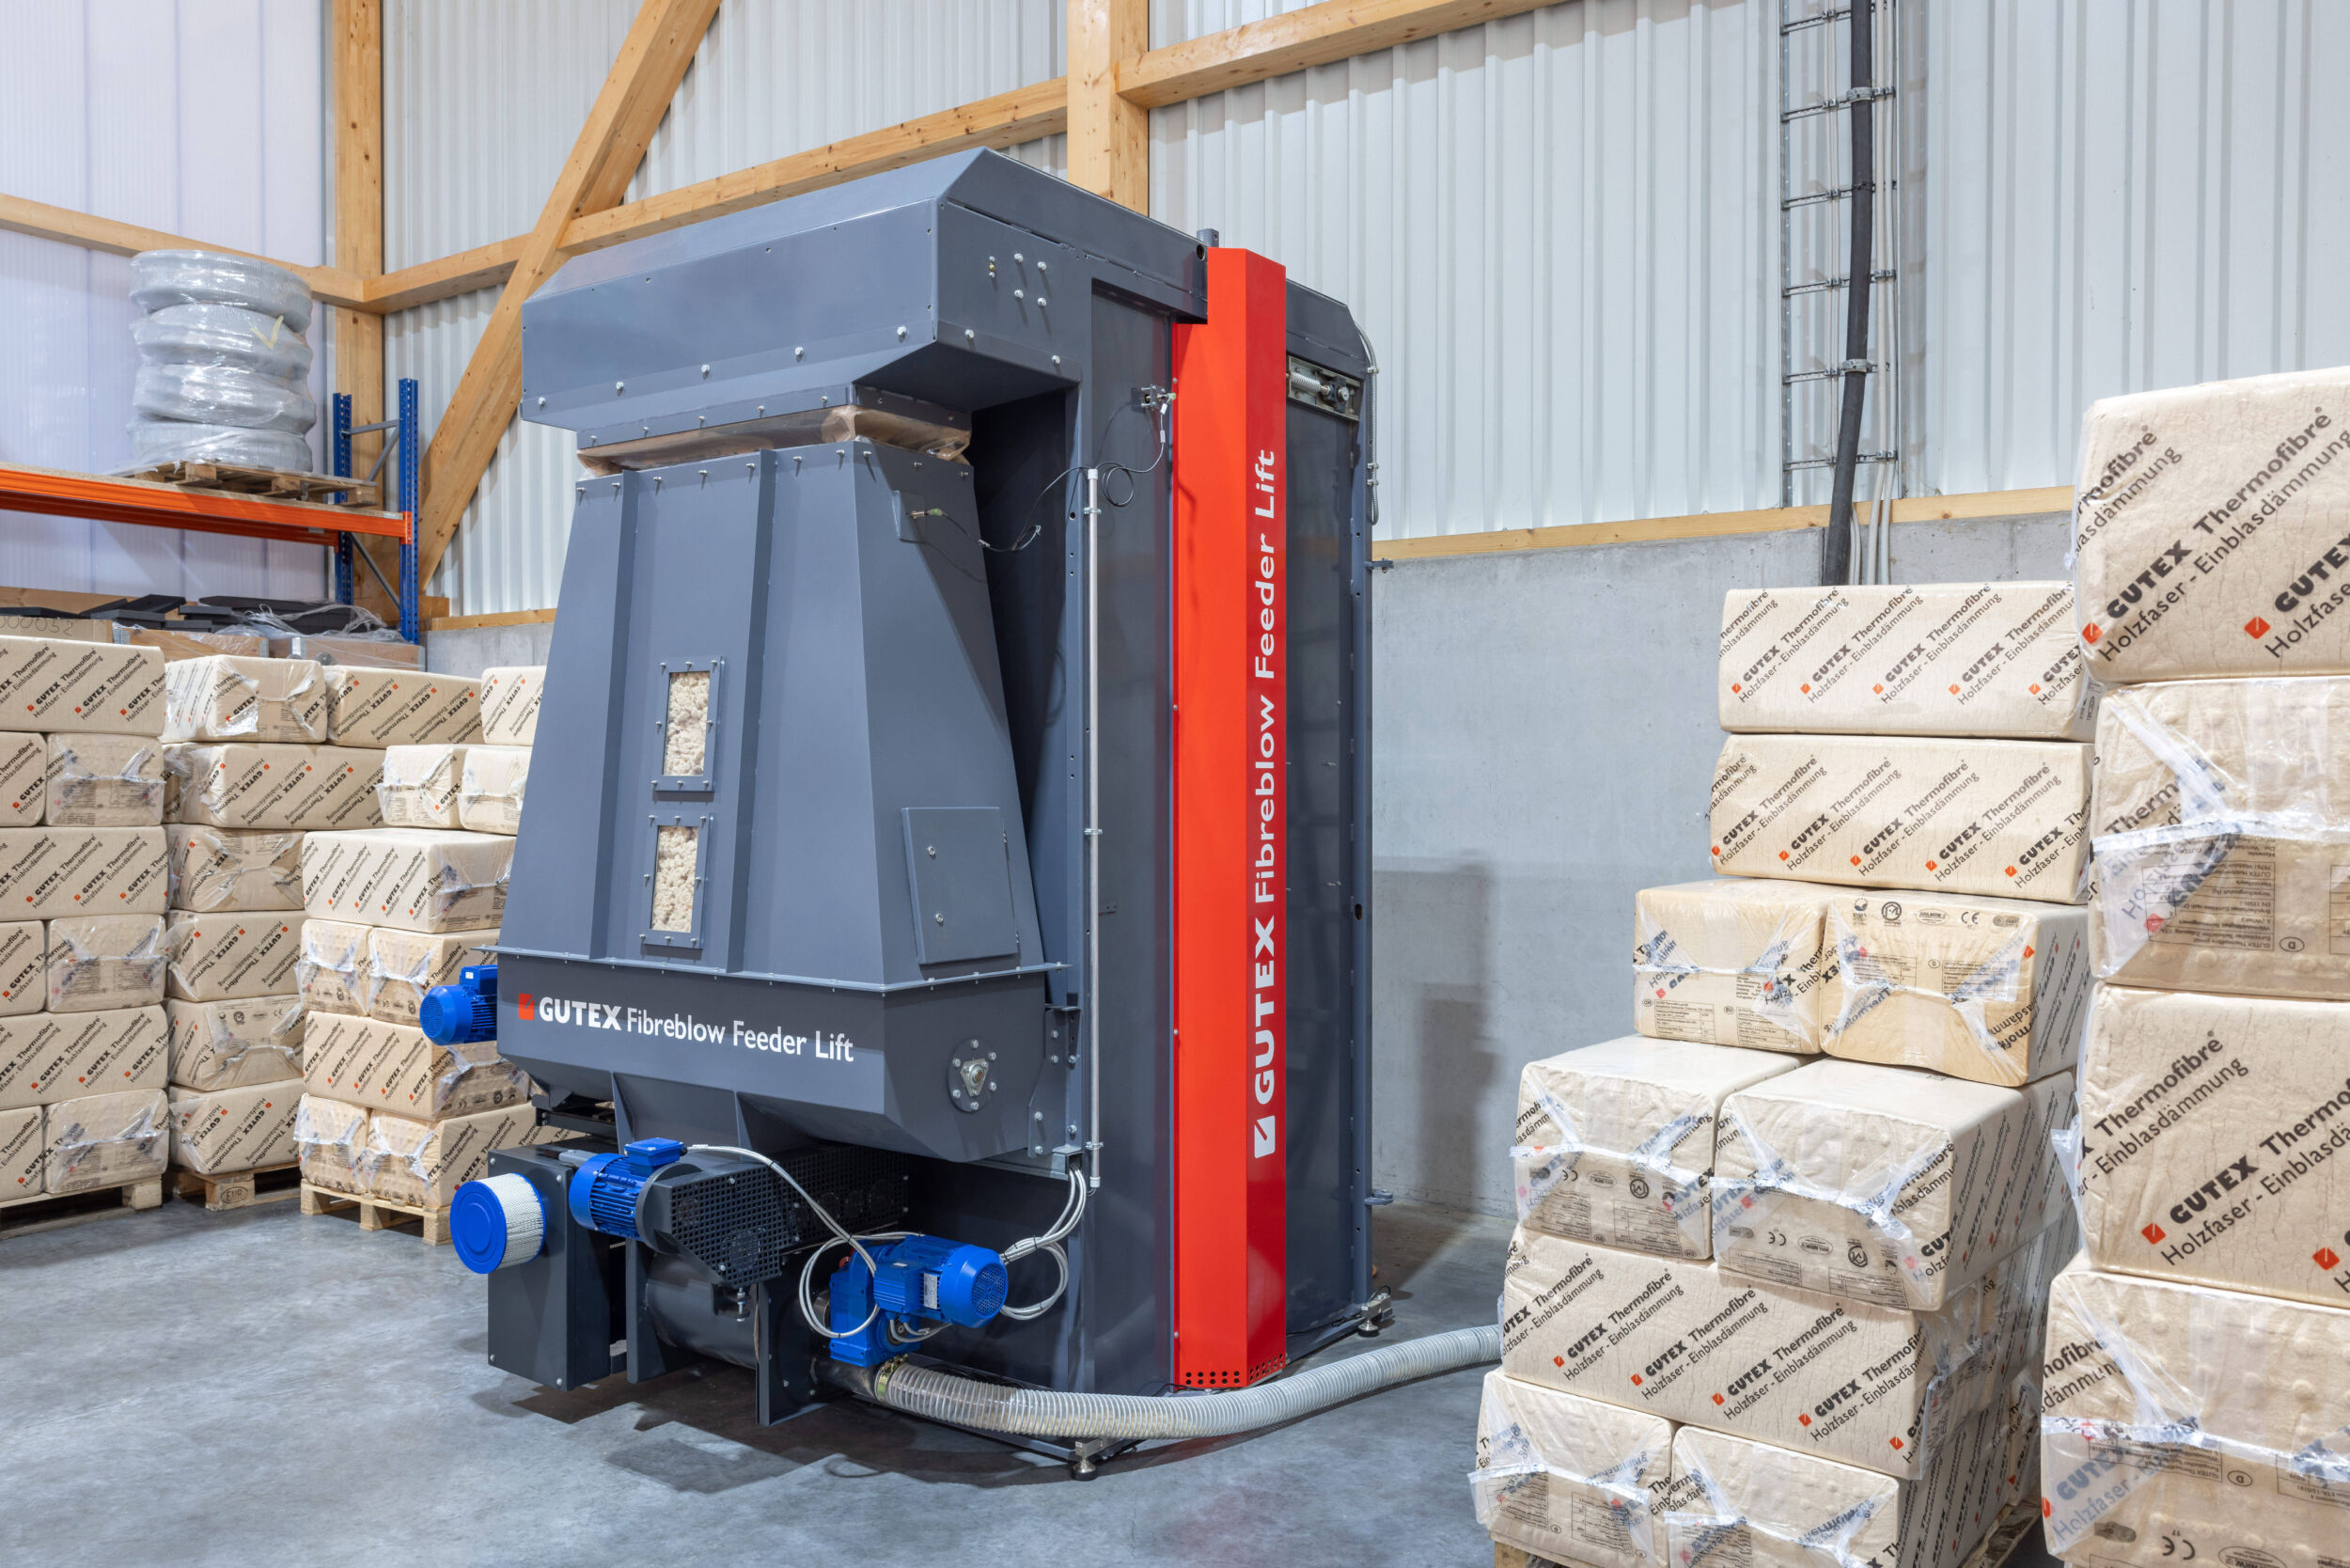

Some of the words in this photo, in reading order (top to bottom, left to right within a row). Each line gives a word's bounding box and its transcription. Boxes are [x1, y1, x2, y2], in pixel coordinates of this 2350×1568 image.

[1255, 449, 1275, 519] Lift
[2106, 540, 2193, 619] GUTEX
[1255, 533, 1275, 679] Feeder
[2099, 581, 2186, 662] Holzfaser
[2264, 588, 2350, 658] Holzfase
[1743, 645, 1780, 682] GUTEX
[1812, 644, 1851, 682] GUTEX
[1885, 643, 1926, 682] GUTEX
[1962, 643, 2005, 682] GUTEX
[36, 682, 60, 705] GUTEX
[83, 684, 106, 707] GUTEX
[128, 687, 151, 710] GUTEX
[1739, 666, 1777, 703] Holzfaser
[1809, 666, 1847, 703] Holzfaser
[1881, 666, 1922, 704] Holzfaser
[1958, 666, 2001, 705] Holzfaser
[20, 776, 44, 800] GUTEX
[240, 771, 263, 792] GUTEX
[283, 772, 306, 793] GUTEX
[1255, 694, 1275, 903] Fibreblow
[1722, 810, 1759, 845] GUTEX
[1791, 813, 1829, 850] GUTEX
[1863, 818, 1904, 855] GUTEX
[1939, 822, 1982, 859] GUTEX
[2019, 827, 2063, 865] GUTEX
[1719, 831, 1756, 865] Holzfaser
[1787, 834, 1826, 871] Holzfaser
[1858, 839, 1900, 876] Holzfaser
[1935, 843, 1978, 882] Holzfaser
[35, 870, 60, 895] GUTEX
[83, 870, 106, 893] GUTEX
[128, 869, 150, 892] GUTEX
[2014, 848, 2060, 888] Holzfaser
[216, 936, 239, 960] GUTEX
[259, 933, 282, 956] GUTEX
[9, 964, 35, 988] GUTEX
[1254, 914, 1276, 1105] GUTEX
[539, 996, 621, 1031] GUTEX
[627, 1008, 726, 1045] Fibreblow
[732, 1020, 807, 1055] Feeder
[816, 1030, 854, 1062] Lift
[39, 1056, 65, 1081] GUTEX
[86, 1050, 111, 1075] GUTEX
[133, 1045, 156, 1070] GUTEX
[244, 1109, 265, 1135] GUTEX
[2095, 1057, 2249, 1175] Einblasdämmung
[2170, 1154, 2259, 1224] GUTEX
[2259, 1077, 2350, 1156] Thermo
[2160, 1195, 2251, 1266] Holzfaser
[1532, 1268, 1604, 1329] Einblasdämmung
[1564, 1344, 1605, 1381] Holzfaser
[1607, 1284, 1684, 1346] Einblasdämmung
[1567, 1323, 1607, 1358] GUTEX
[1641, 1363, 1684, 1400] Holzfaser
[1688, 1300, 1768, 1364] Einblasdämmung
[1645, 1341, 1688, 1376] GUTEX
[1724, 1384, 1769, 1420] Holzfaser
[1773, 1320, 1857, 1384] Einblasdämmung
[1727, 1358, 1773, 1397] GUTEX
[1814, 1379, 1861, 1417] GUTEX
[1810, 1404, 1858, 1442] Holzfaser
